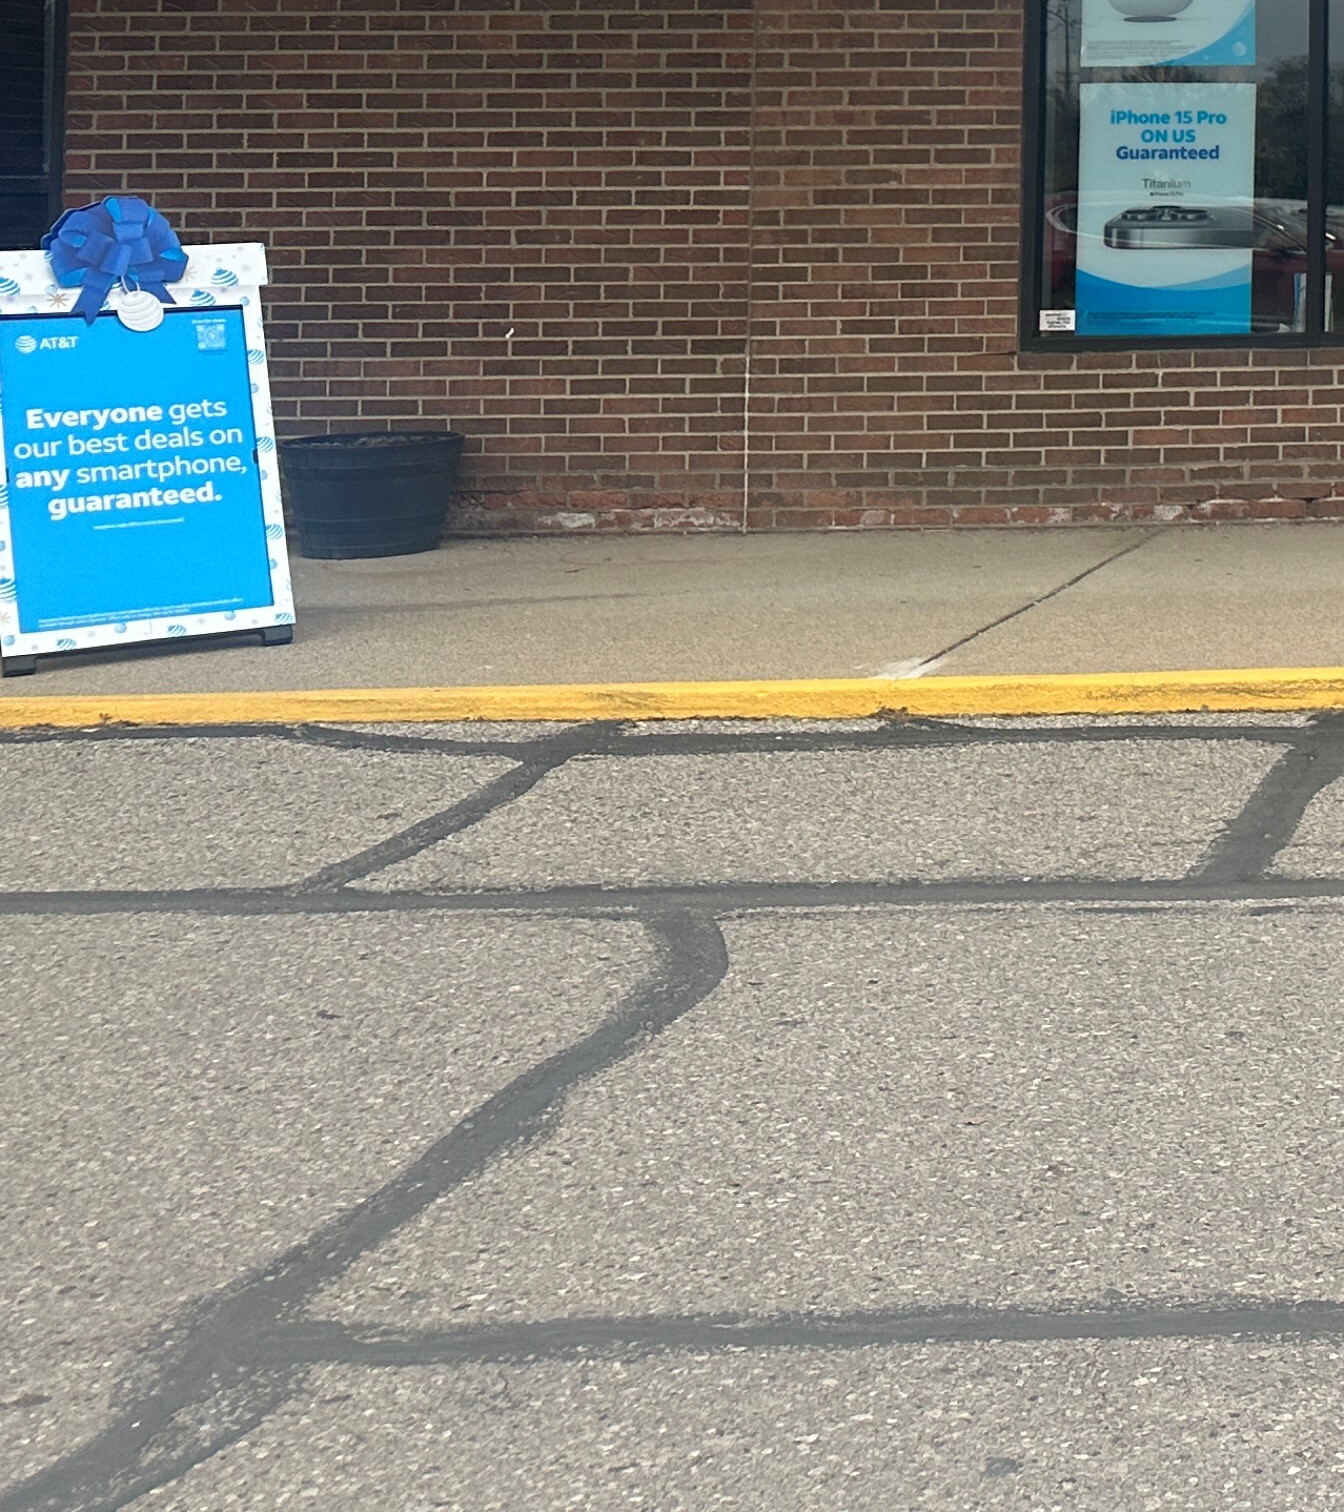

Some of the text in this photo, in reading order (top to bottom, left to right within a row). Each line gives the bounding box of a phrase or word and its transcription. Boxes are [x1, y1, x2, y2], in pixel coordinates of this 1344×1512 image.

[1110, 110, 1227, 125] iPhone 15 Pro
[1140, 129, 1197, 144] ON US
[1115, 145, 1221, 161] Guaranteed
[1141, 178, 1192, 189] Titanium
[39, 336, 79, 350] AT&T
[26, 398, 227, 431] Everyone gets
[13, 426, 243, 460] our best deals on
[15, 455, 248, 492] any smartphone,
[47, 480, 223, 521] guaranteed.
